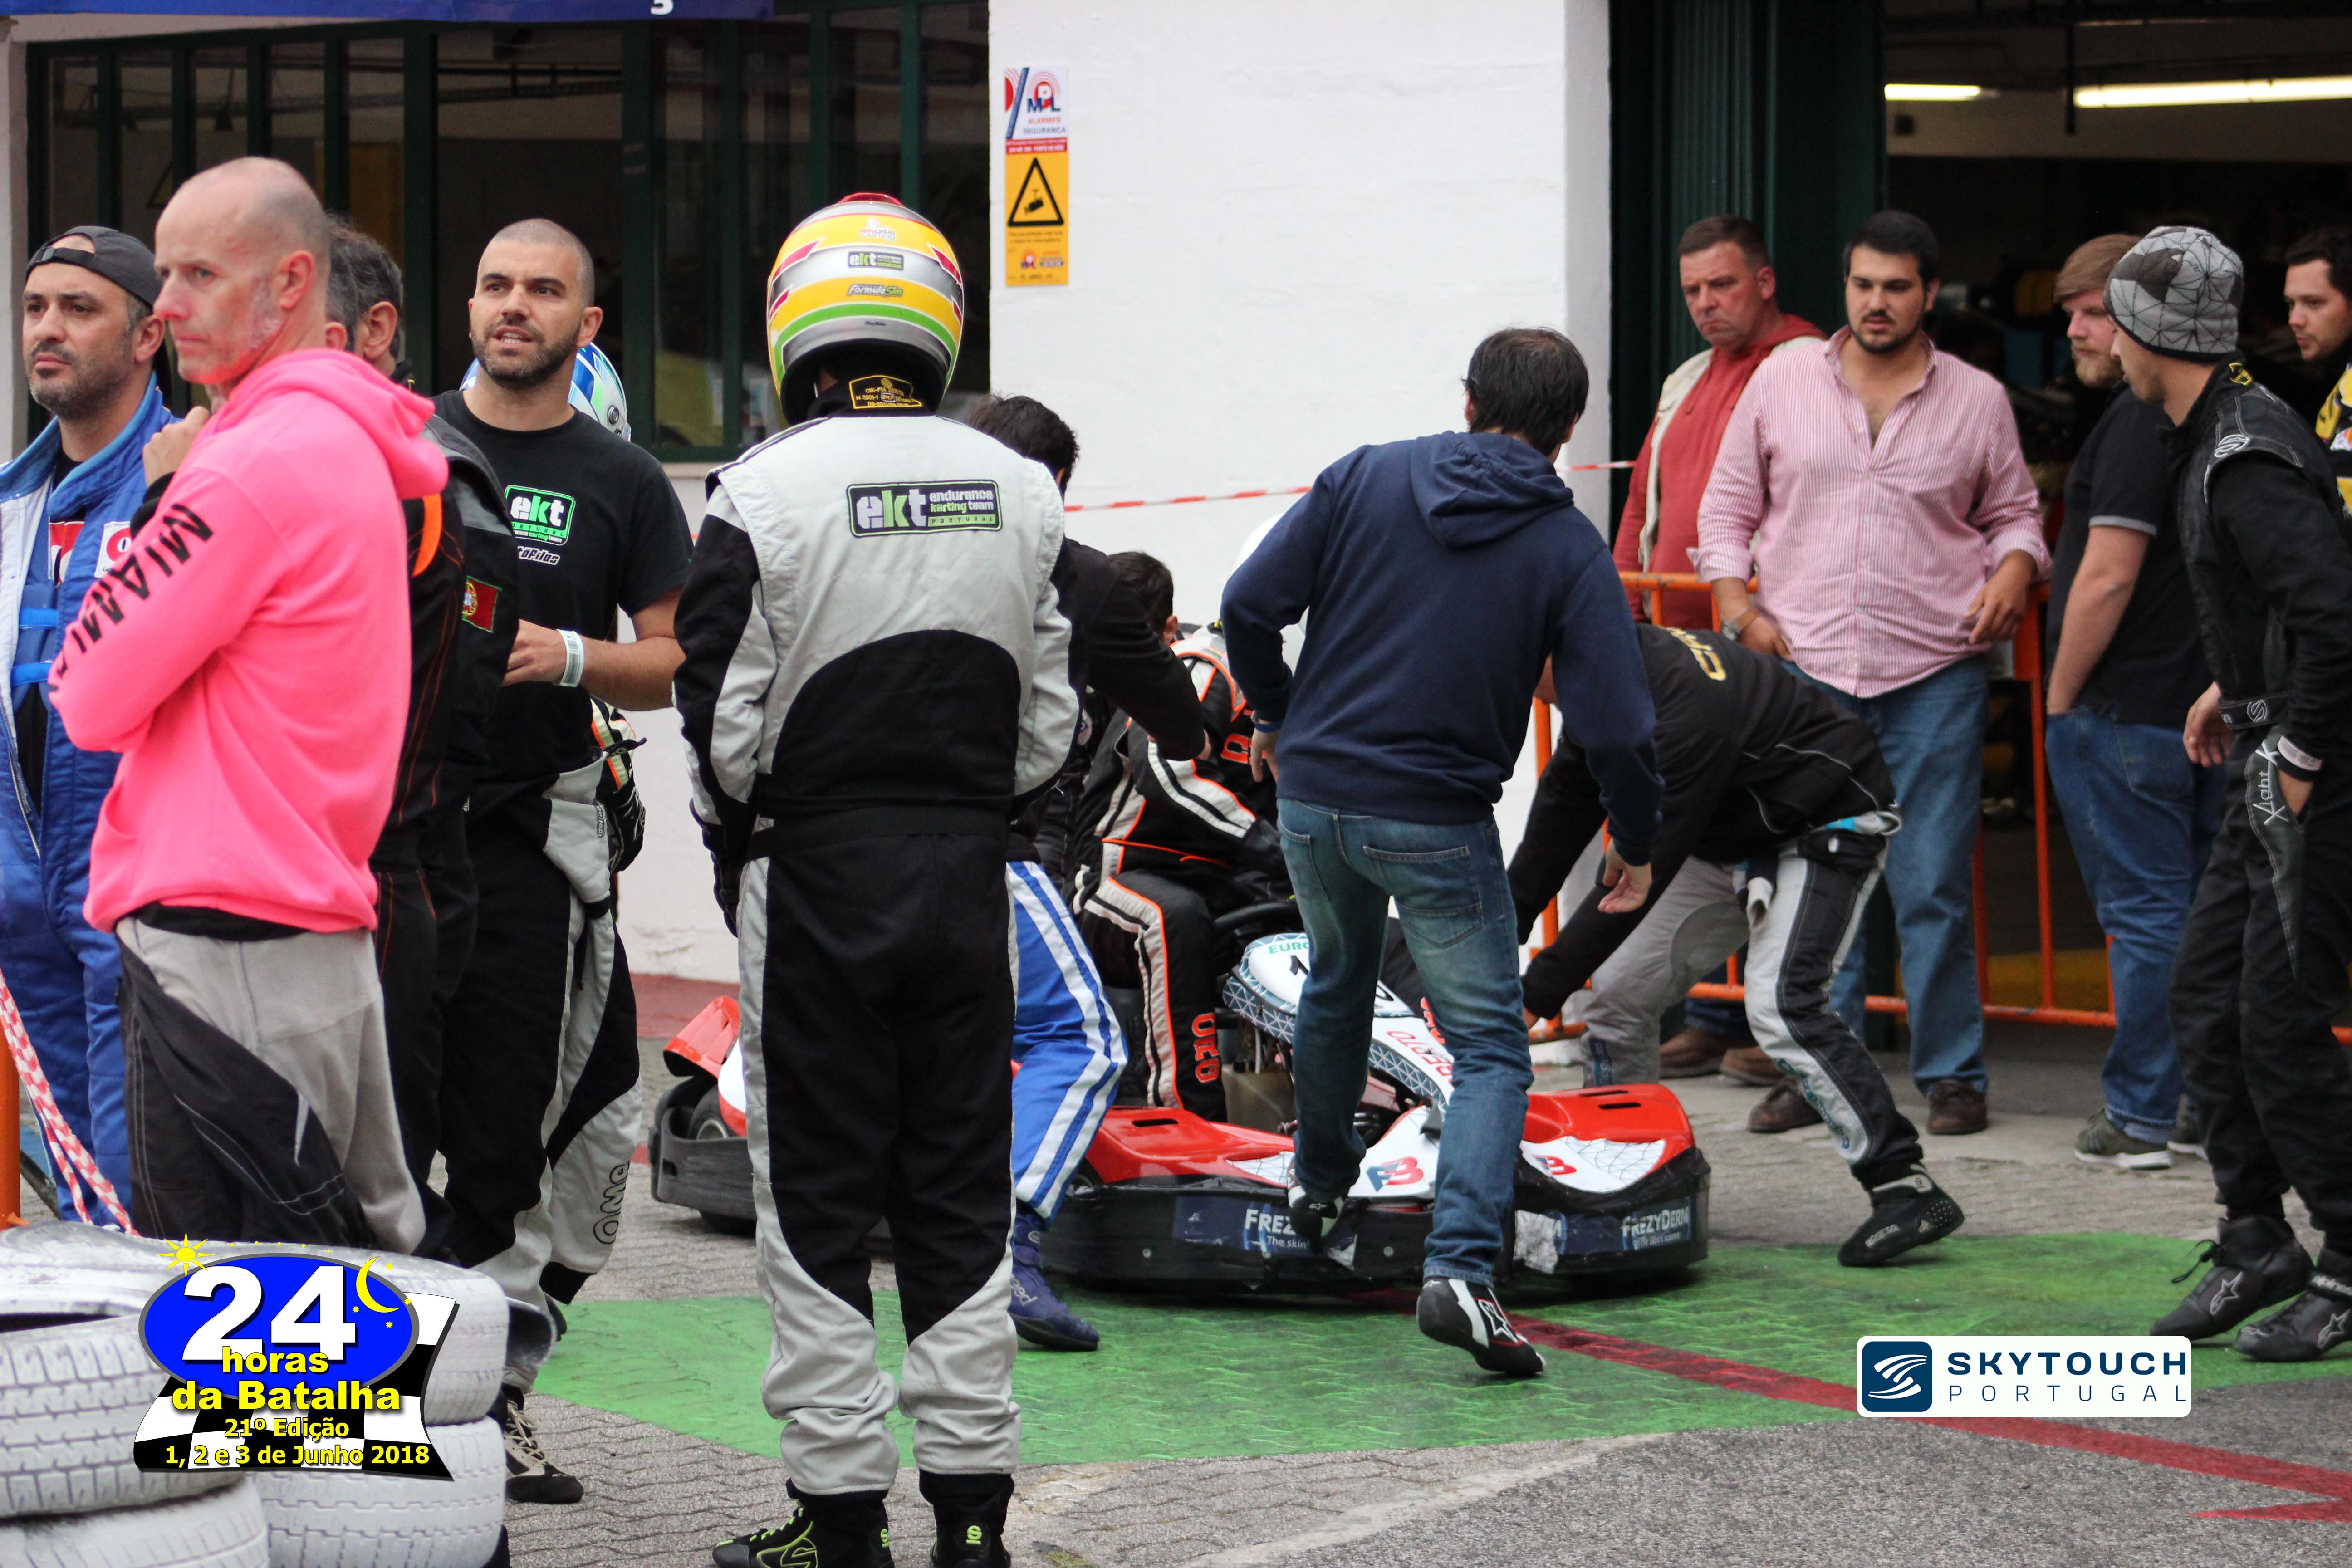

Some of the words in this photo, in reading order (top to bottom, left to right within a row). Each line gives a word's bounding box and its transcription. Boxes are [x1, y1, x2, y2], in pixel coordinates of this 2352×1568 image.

[850, 253, 877, 266] ekt
[929, 490, 993, 502] endurance
[510, 495, 564, 527] ekt
[856, 488, 926, 529] ekt
[930, 502, 967, 514] karting
[968, 501, 994, 510] team
[512, 523, 564, 537] ORTUGAL
[1267, 1235, 1284, 1246] The
[1287, 1236, 1310, 1249] skin'
